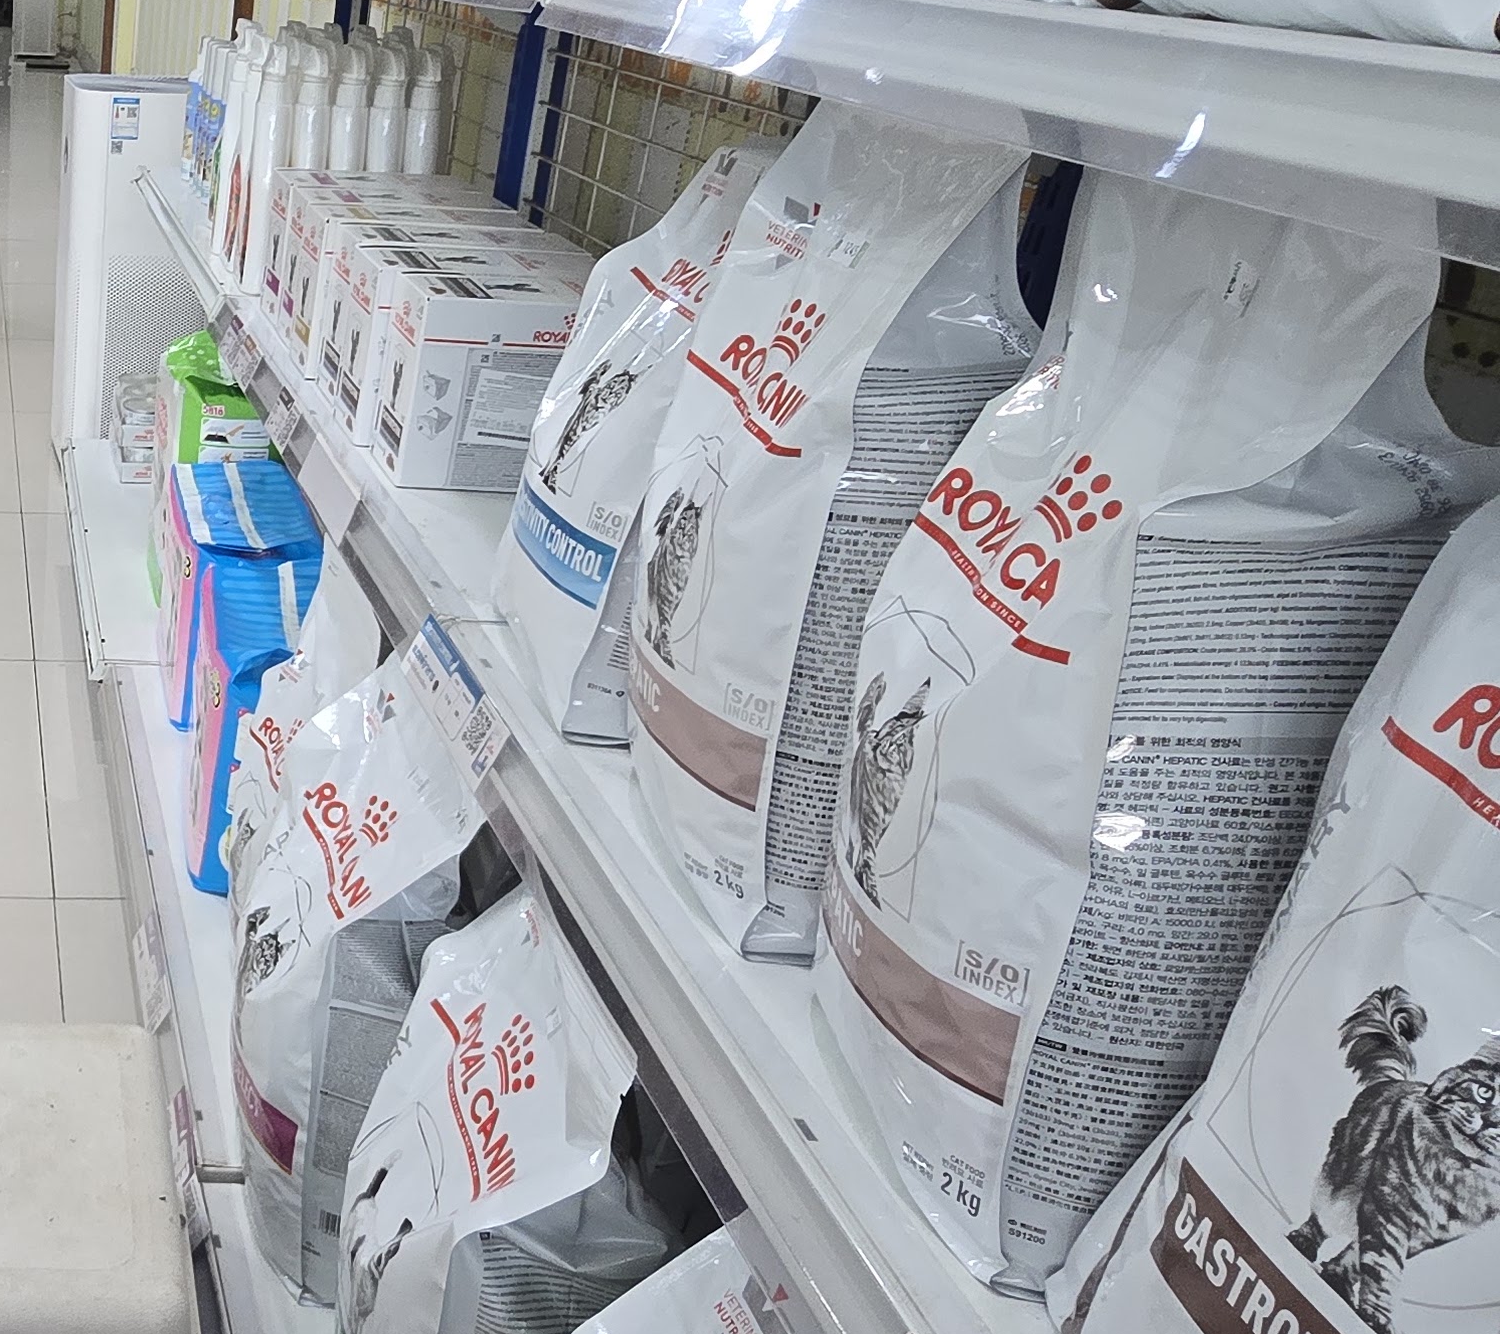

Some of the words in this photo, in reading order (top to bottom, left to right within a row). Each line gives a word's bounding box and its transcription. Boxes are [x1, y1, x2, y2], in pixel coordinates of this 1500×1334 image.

[546, 527, 603, 582] CONTROL
[728, 704, 766, 728] INDEX
[730, 688, 769, 714] S/O
[1163, 756, 1208, 766] HEPATIC
[1203, 795, 1248, 806] HEPATIC
[714, 870, 723, 886] 2
[726, 874, 744, 900] kg
[964, 949, 1020, 984] S/O
[962, 971, 1016, 1005] INDEX
[941, 1171, 951, 1196] 2
[957, 1180, 981, 1218] kg
